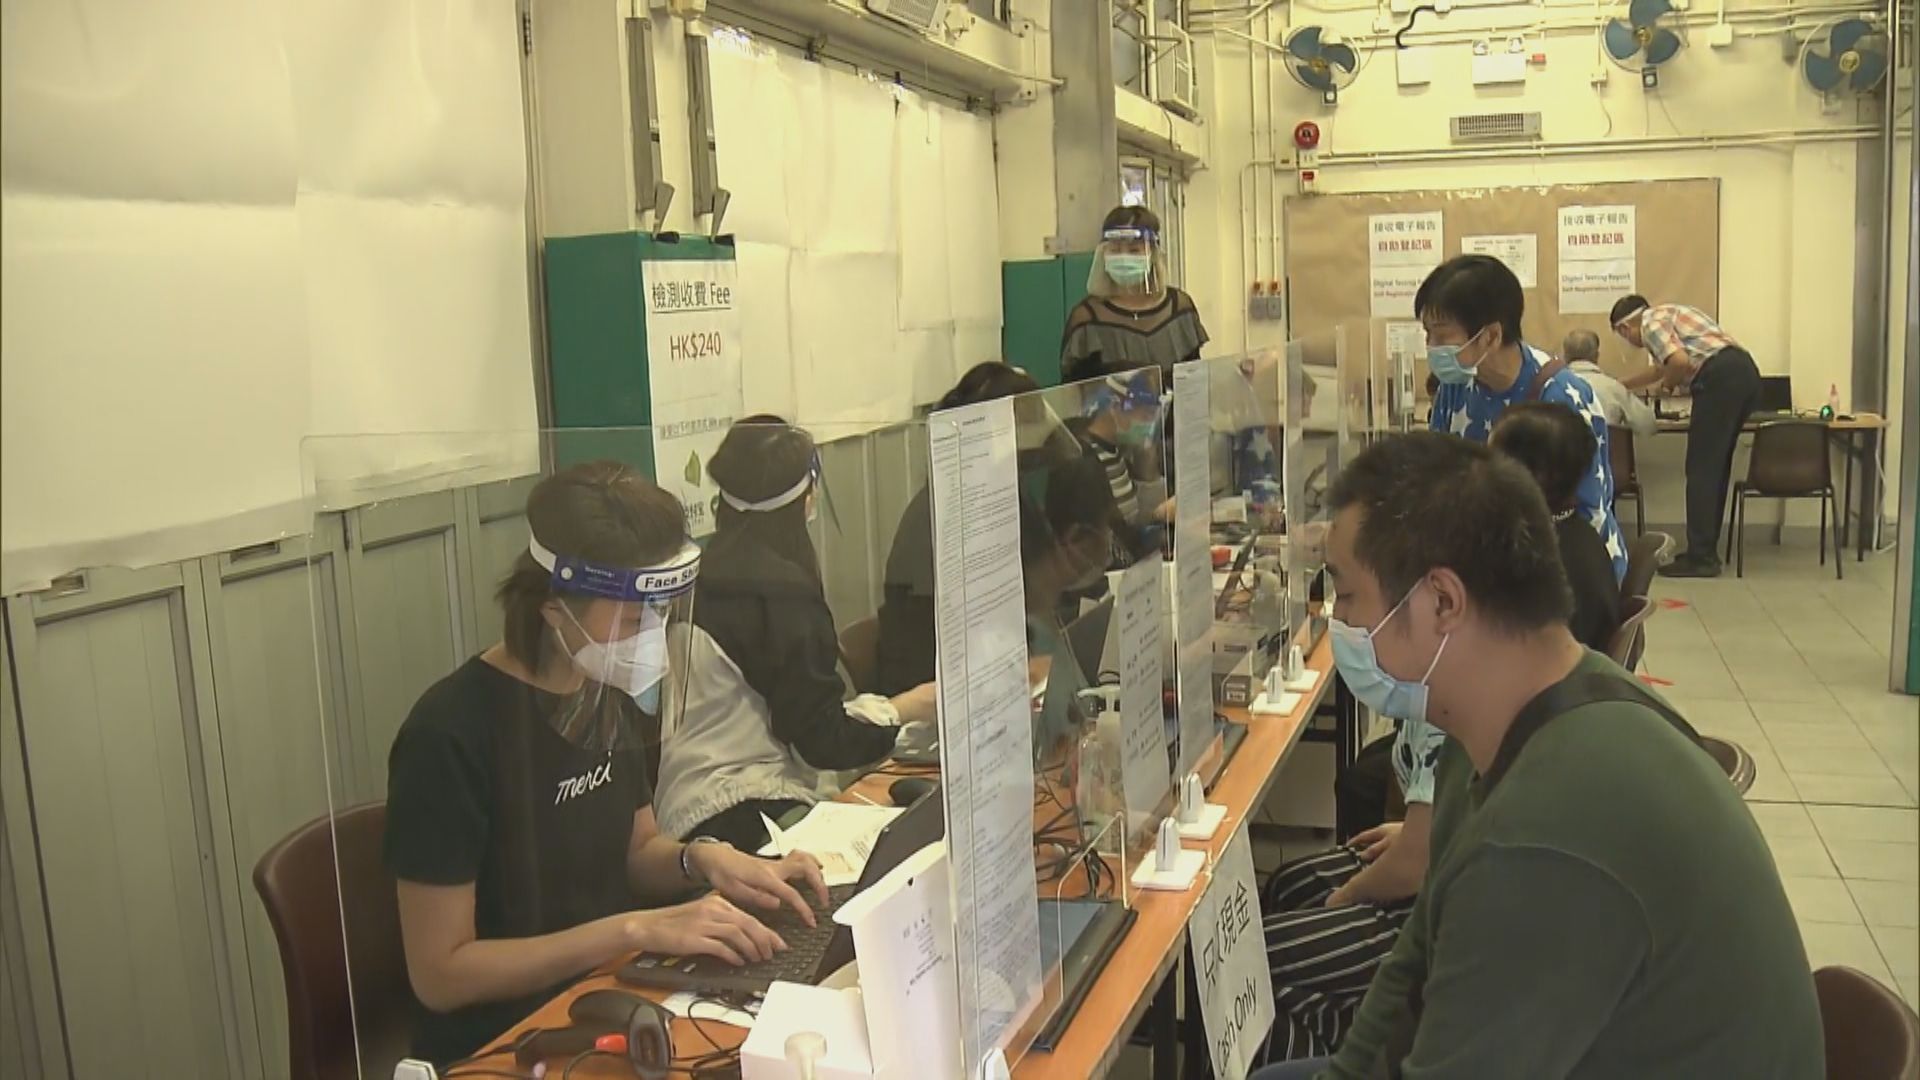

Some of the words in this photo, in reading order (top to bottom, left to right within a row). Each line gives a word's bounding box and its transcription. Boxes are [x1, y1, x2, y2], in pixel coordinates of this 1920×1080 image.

[652, 280, 707, 308] 檢測收費
[710, 281, 730, 305] Fee
[670, 331, 721, 361] HK$240
[645, 576, 678, 589] Face
[555, 750, 612, 805] merci
[1217, 1016, 1236, 1077] Cash
[1234, 976, 1257, 1031] Only
